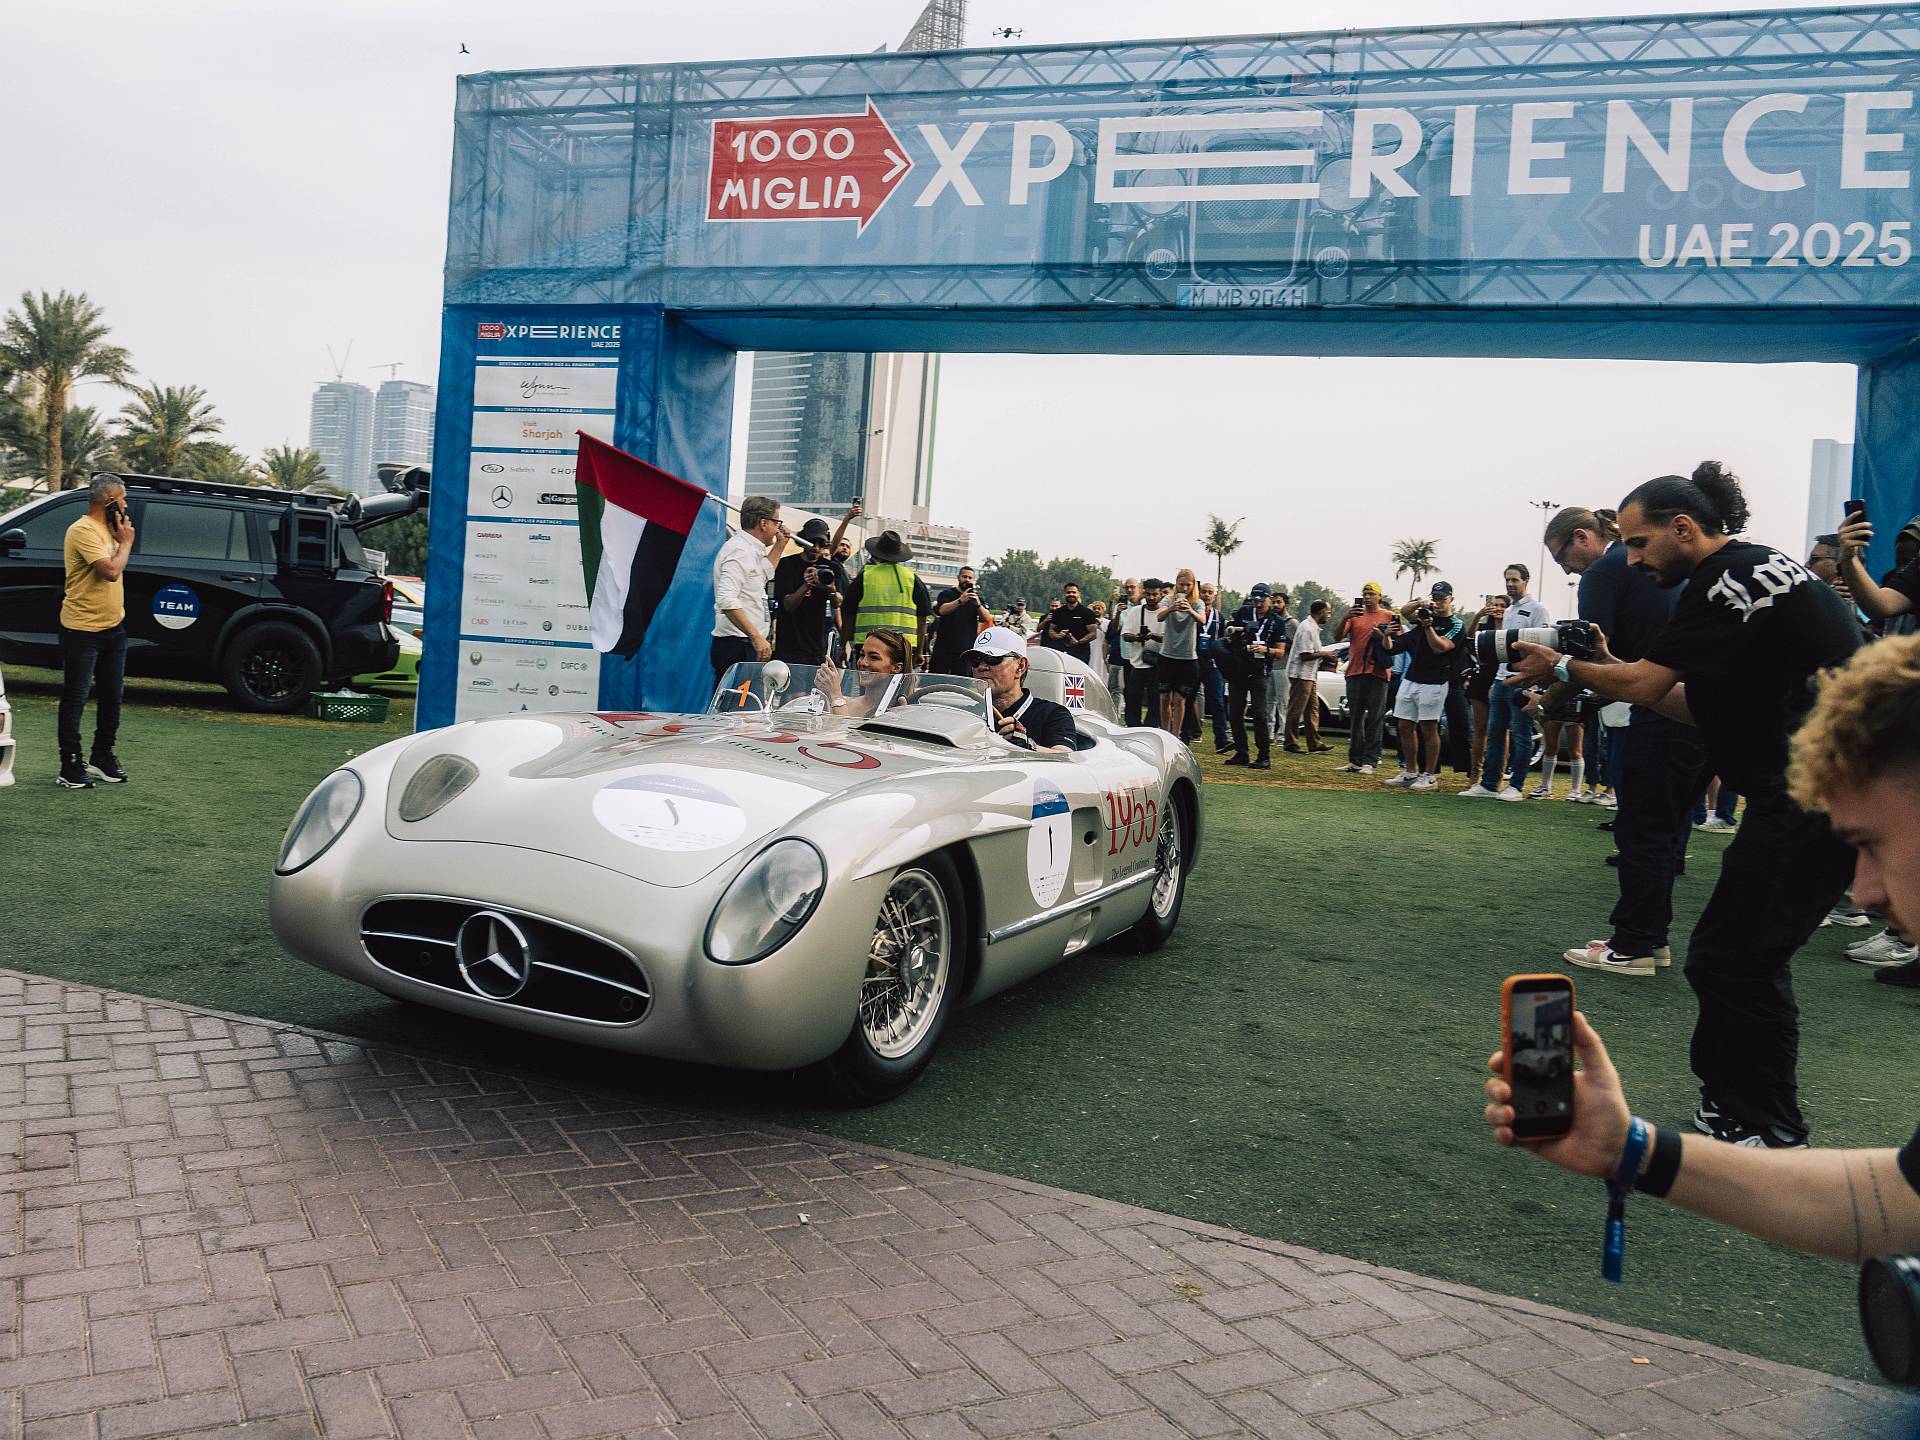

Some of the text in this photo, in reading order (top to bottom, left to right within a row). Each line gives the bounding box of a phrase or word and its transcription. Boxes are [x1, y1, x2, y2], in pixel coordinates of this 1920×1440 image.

[731, 127, 855, 163] 1000
[913, 91, 1914, 206] XPERIENCE
[718, 175, 861, 211] MIGLIA
[1637, 220, 1913, 268] UAE 2025
[506, 325, 621, 338] XPERIENCE
[522, 429, 563, 440] Sharjah
[159, 601, 194, 612] TEAM
[737, 680, 751, 707] 1
[1106, 777, 1158, 857] 1955
